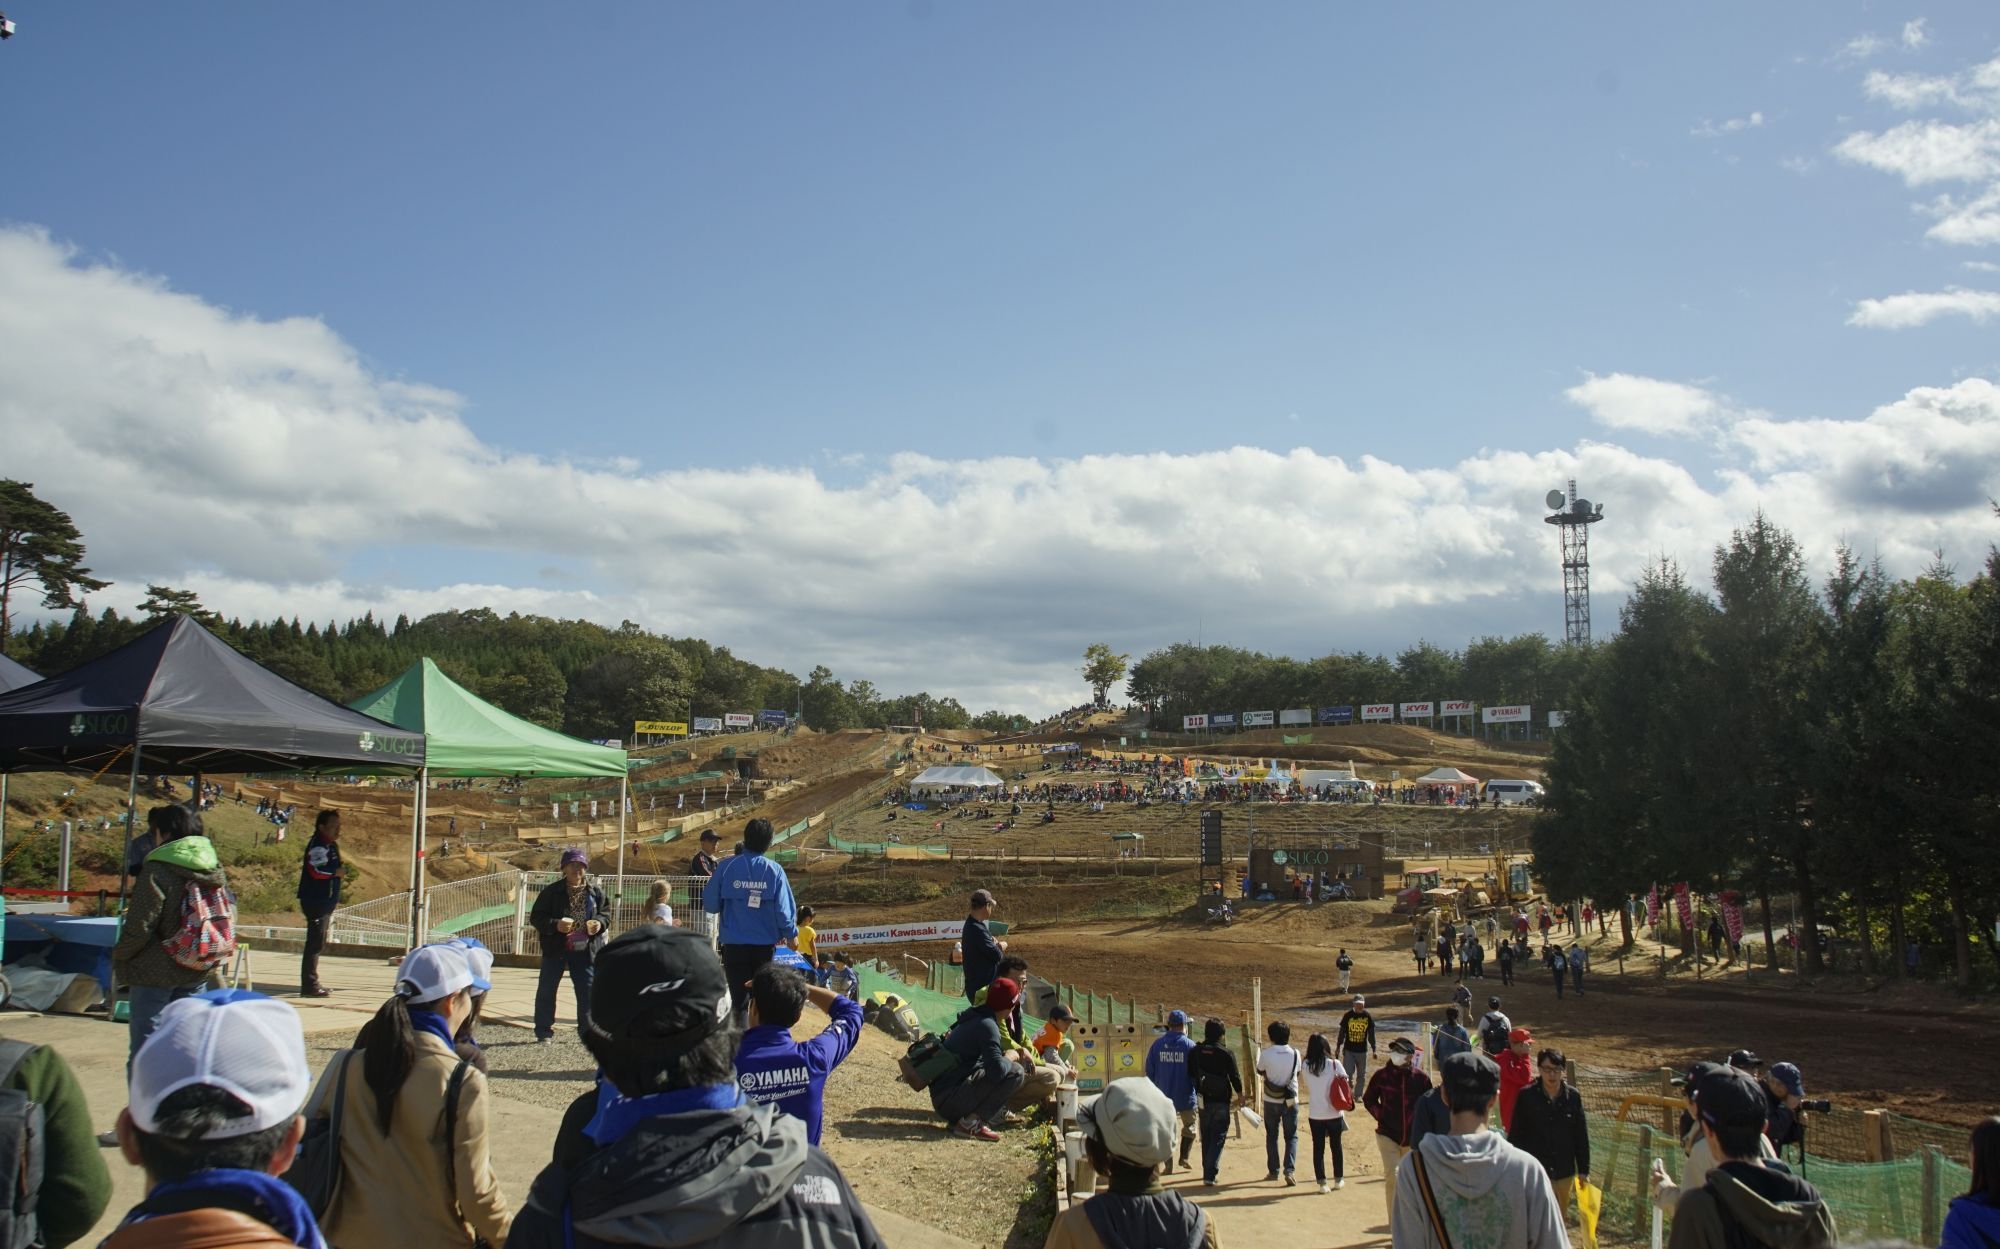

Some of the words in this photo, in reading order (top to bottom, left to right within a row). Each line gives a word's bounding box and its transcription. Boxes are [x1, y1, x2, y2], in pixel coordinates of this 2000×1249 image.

[1497, 708, 1521, 716] YAMAHA
[84, 714, 127, 735] SUGO
[648, 724, 683, 732] DUNLOP
[374, 735, 416, 755] SUGO
[1288, 851, 1329, 865] SUGO
[741, 880, 767, 889] YAMAHA
[816, 933, 840, 943] MAHA
[852, 932, 889, 940] SUZUKI
[890, 926, 937, 937] Kawasaki
[756, 1066, 809, 1086] YAMAHA
